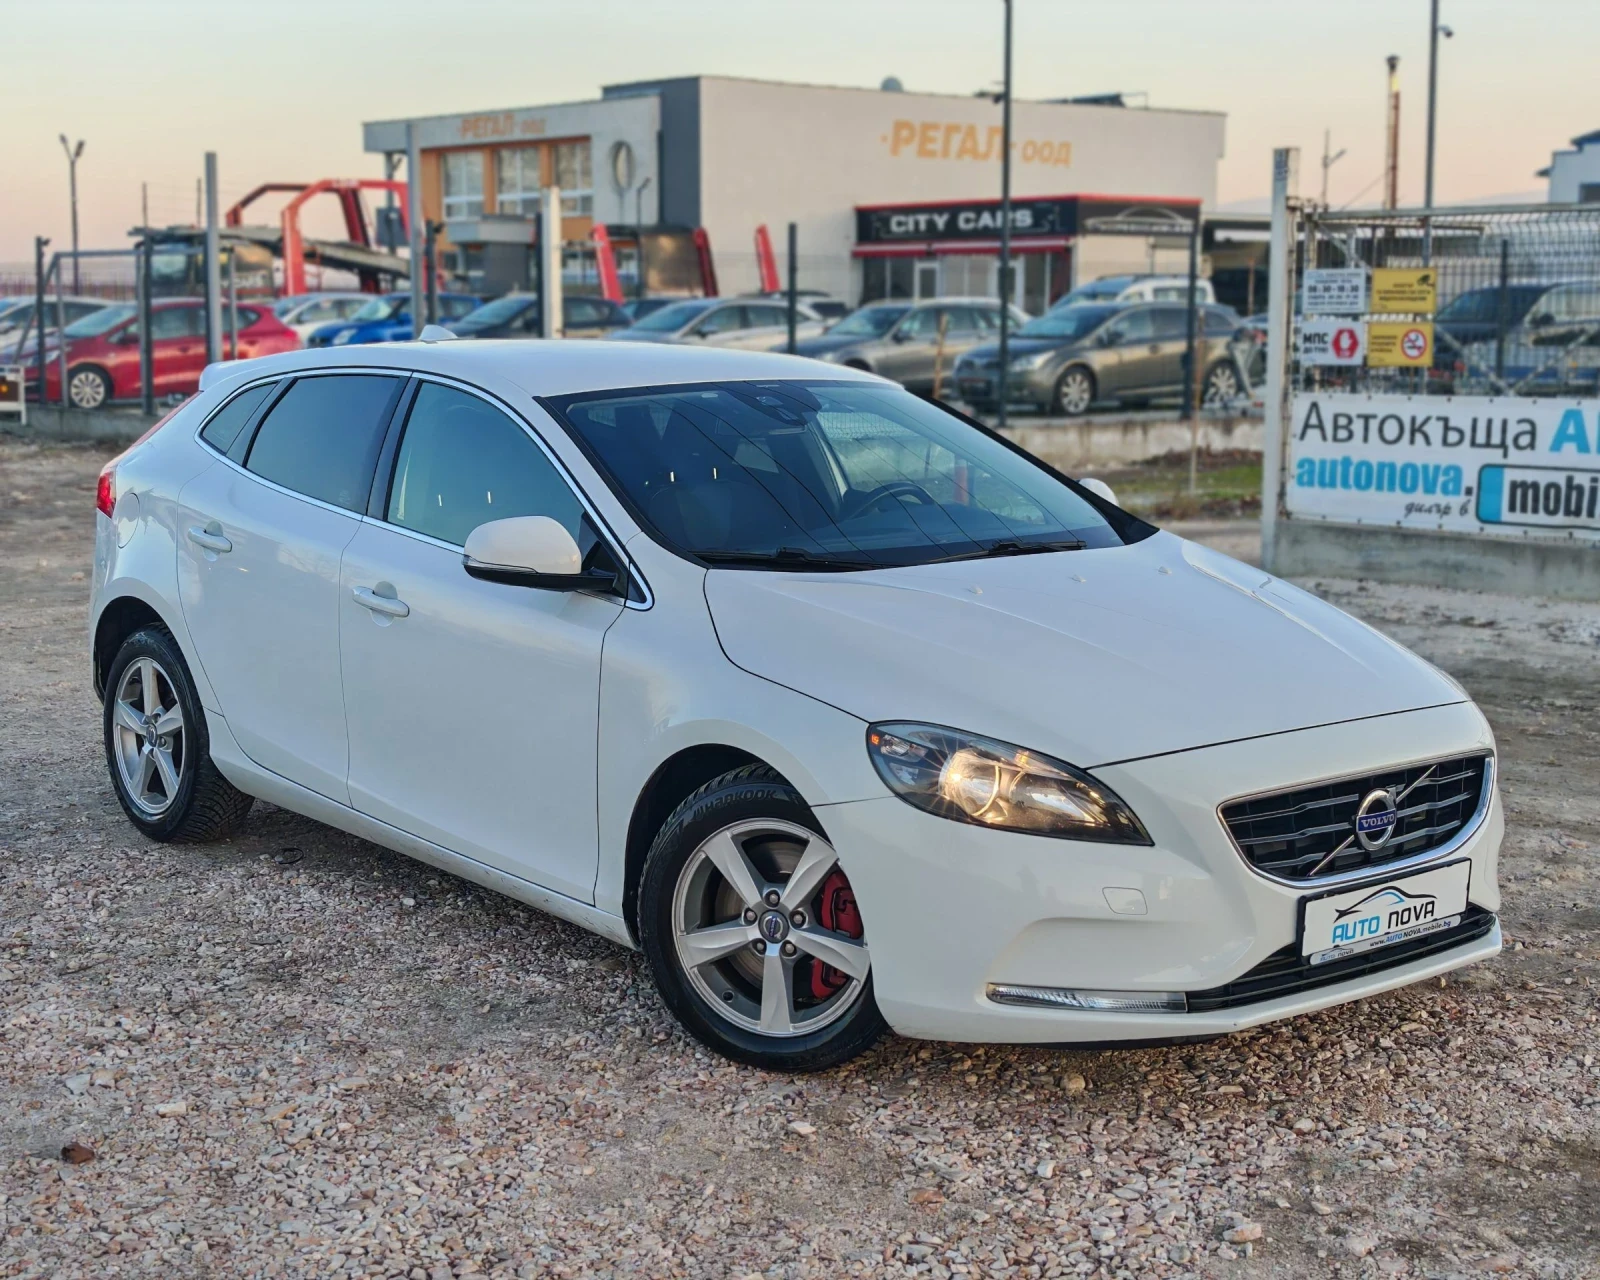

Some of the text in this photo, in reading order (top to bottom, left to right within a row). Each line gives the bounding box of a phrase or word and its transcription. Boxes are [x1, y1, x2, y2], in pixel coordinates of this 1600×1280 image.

[889, 119, 1007, 162] РЕГАЛ
[890, 208, 1033, 234] CITY CARS
[1303, 332, 1329, 345] МПС
[1299, 401, 1537, 459] Автокъща
[1361, 813, 1395, 828] VOLVO
[1332, 900, 1435, 944] AUTO NOVA
